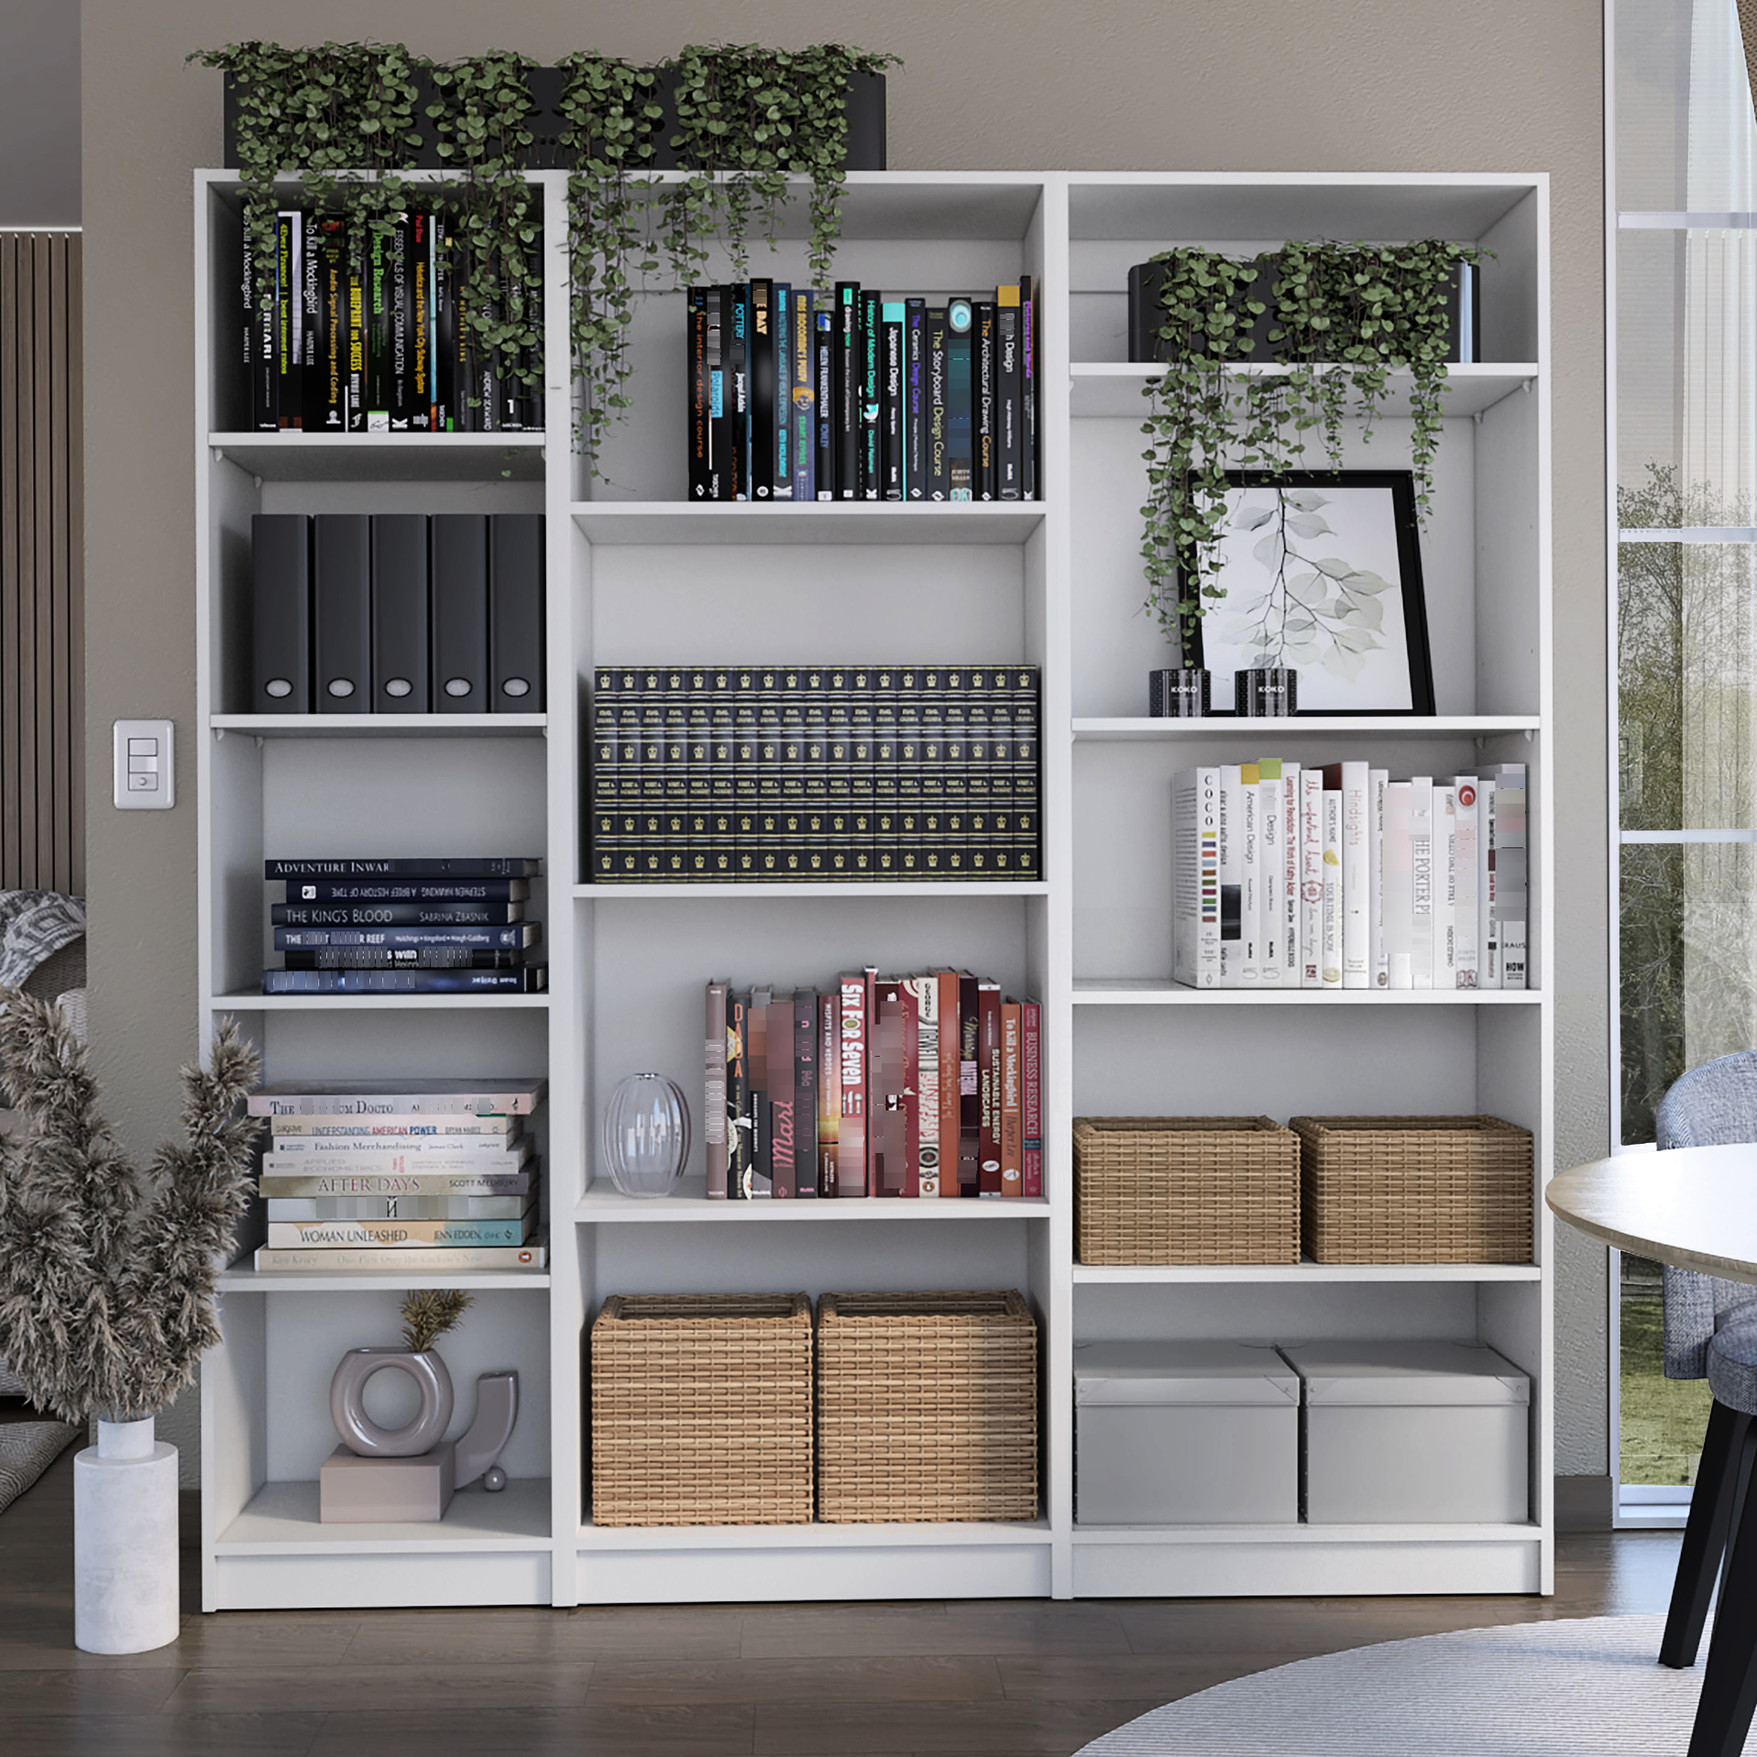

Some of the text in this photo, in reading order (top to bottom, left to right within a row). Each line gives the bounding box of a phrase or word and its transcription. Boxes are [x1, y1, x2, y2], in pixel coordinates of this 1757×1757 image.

[306, 223, 318, 235] To
[306, 236, 318, 250] Kill
[370, 232, 384, 266] Design
[394, 230, 404, 271] ESSENALS
[241, 251, 252, 309] Mockingbird
[303, 259, 318, 314] Mockingbird
[394, 273, 404, 285] OF
[416, 262, 425, 287] Helvetica
[373, 268, 385, 315] Research
[394, 285, 404, 311] VISUAL
[416, 287, 425, 300] and
[416, 300, 424, 310] the
[280, 299, 288, 318] best
[350, 287, 362, 328] BLUEPRINT
[735, 303, 745, 340] POTTERY
[866, 300, 875, 329] History
[263, 294, 272, 359] FRRARI
[280, 320, 288, 352] interest
[327, 269, 339, 404] Audio Signal Processing and Coding
[416, 323, 425, 337] York
[756, 310, 768, 336] DAY
[868, 329, 875, 338] of
[350, 341, 362, 371] SUCCESS
[394, 312, 404, 375] COMMUNICATION
[414, 337, 425, 349] City
[306, 355, 314, 366] LEE
[414, 349, 426, 372] Subway
[887, 327, 899, 397] Japanese Design
[910, 314, 921, 414] The Ceramics Design Course
[1003, 342, 1015, 373] Design
[695, 312, 705, 459] the interior design course
[711, 371, 722, 417] Polaroids
[866, 370, 875, 398] Design
[980, 320, 991, 468] The Architectural Drawing Course
[931, 329, 944, 477] The Storyboard Design Course
[1171, 685, 1197, 693] KOKO
[1258, 684, 1284, 693] KOKO
[1245, 791, 1256, 864] American Design
[1265, 814, 1277, 846] Design
[1345, 789, 1363, 846] Hindsights
[1415, 839, 1431, 903] HE PORTER
[286, 908, 393, 923] THE KING'S BLOOD
[286, 934, 302, 944] THE
[366, 934, 386, 944] REEF
[1005, 1030, 1017, 1045] Kill
[1006, 1018, 1017, 1029] To
[1026, 1031, 1038, 1080] BUSINESS
[1004, 1053, 1017, 1107] Mockingbird
[270, 1101, 295, 1115] THE
[357, 1100, 394, 1114] DOCTO
[982, 1069, 991, 1128] LANDSCAPES
[991, 1048, 1000, 1144] SUSTAINABLE ENERGY
[1026, 1081, 1038, 1136] RESEARCH
[312, 1126, 437, 1136] UNDERSTANDING AMERICAN POWER
[314, 1142, 422, 1152] Fashion Merchandising
[318, 1178, 420, 1192] AFTER DAYS
[449, 1179, 475, 1188] SCOTT
[301, 1230, 408, 1242] WOMAN UNLEASHED
